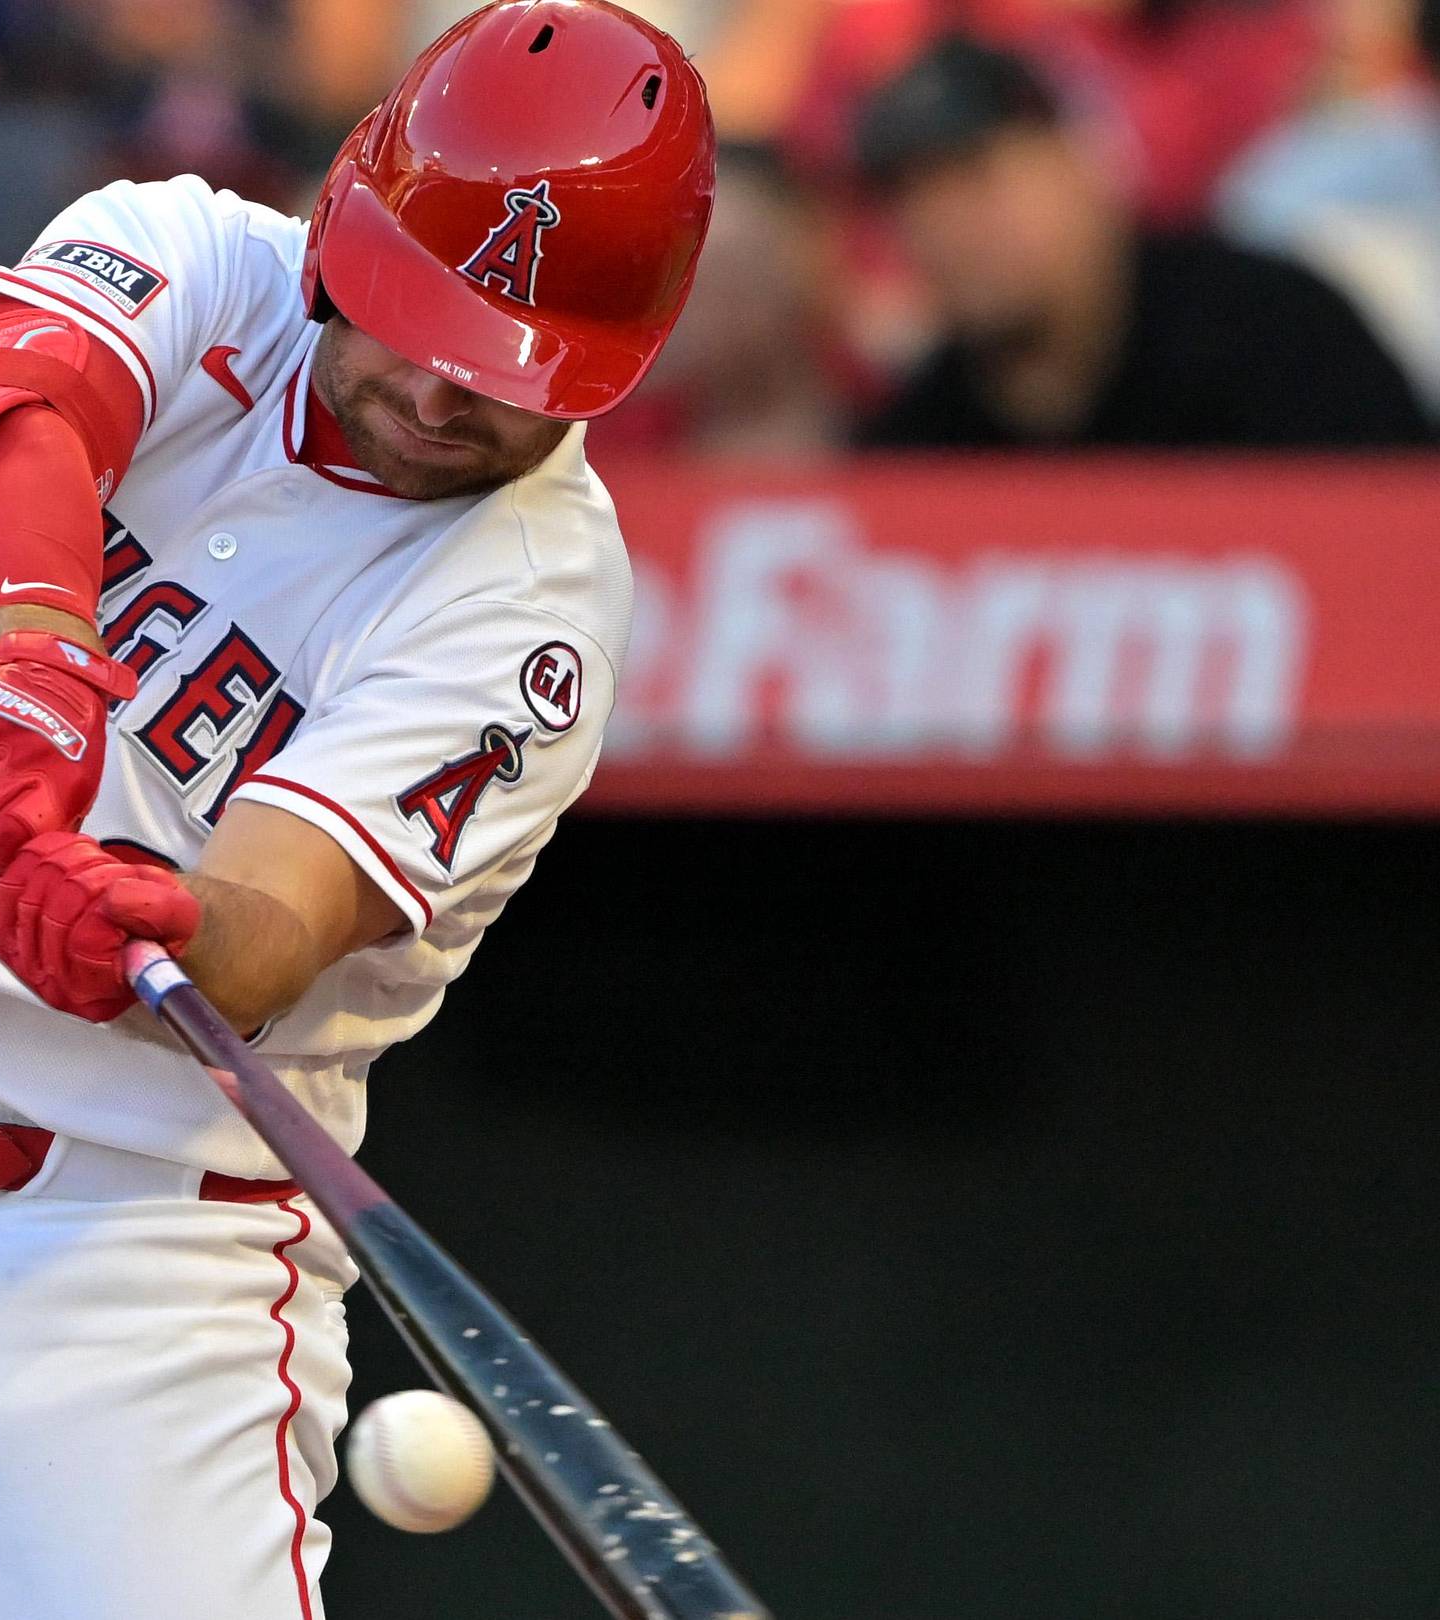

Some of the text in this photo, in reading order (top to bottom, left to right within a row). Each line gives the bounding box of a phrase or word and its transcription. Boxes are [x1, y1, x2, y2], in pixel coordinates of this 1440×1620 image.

[61, 246, 144, 292] FBM
[91, 276, 135, 312] Materials
[431, 355, 473, 382] WALTON
[529, 653, 575, 718] GA
